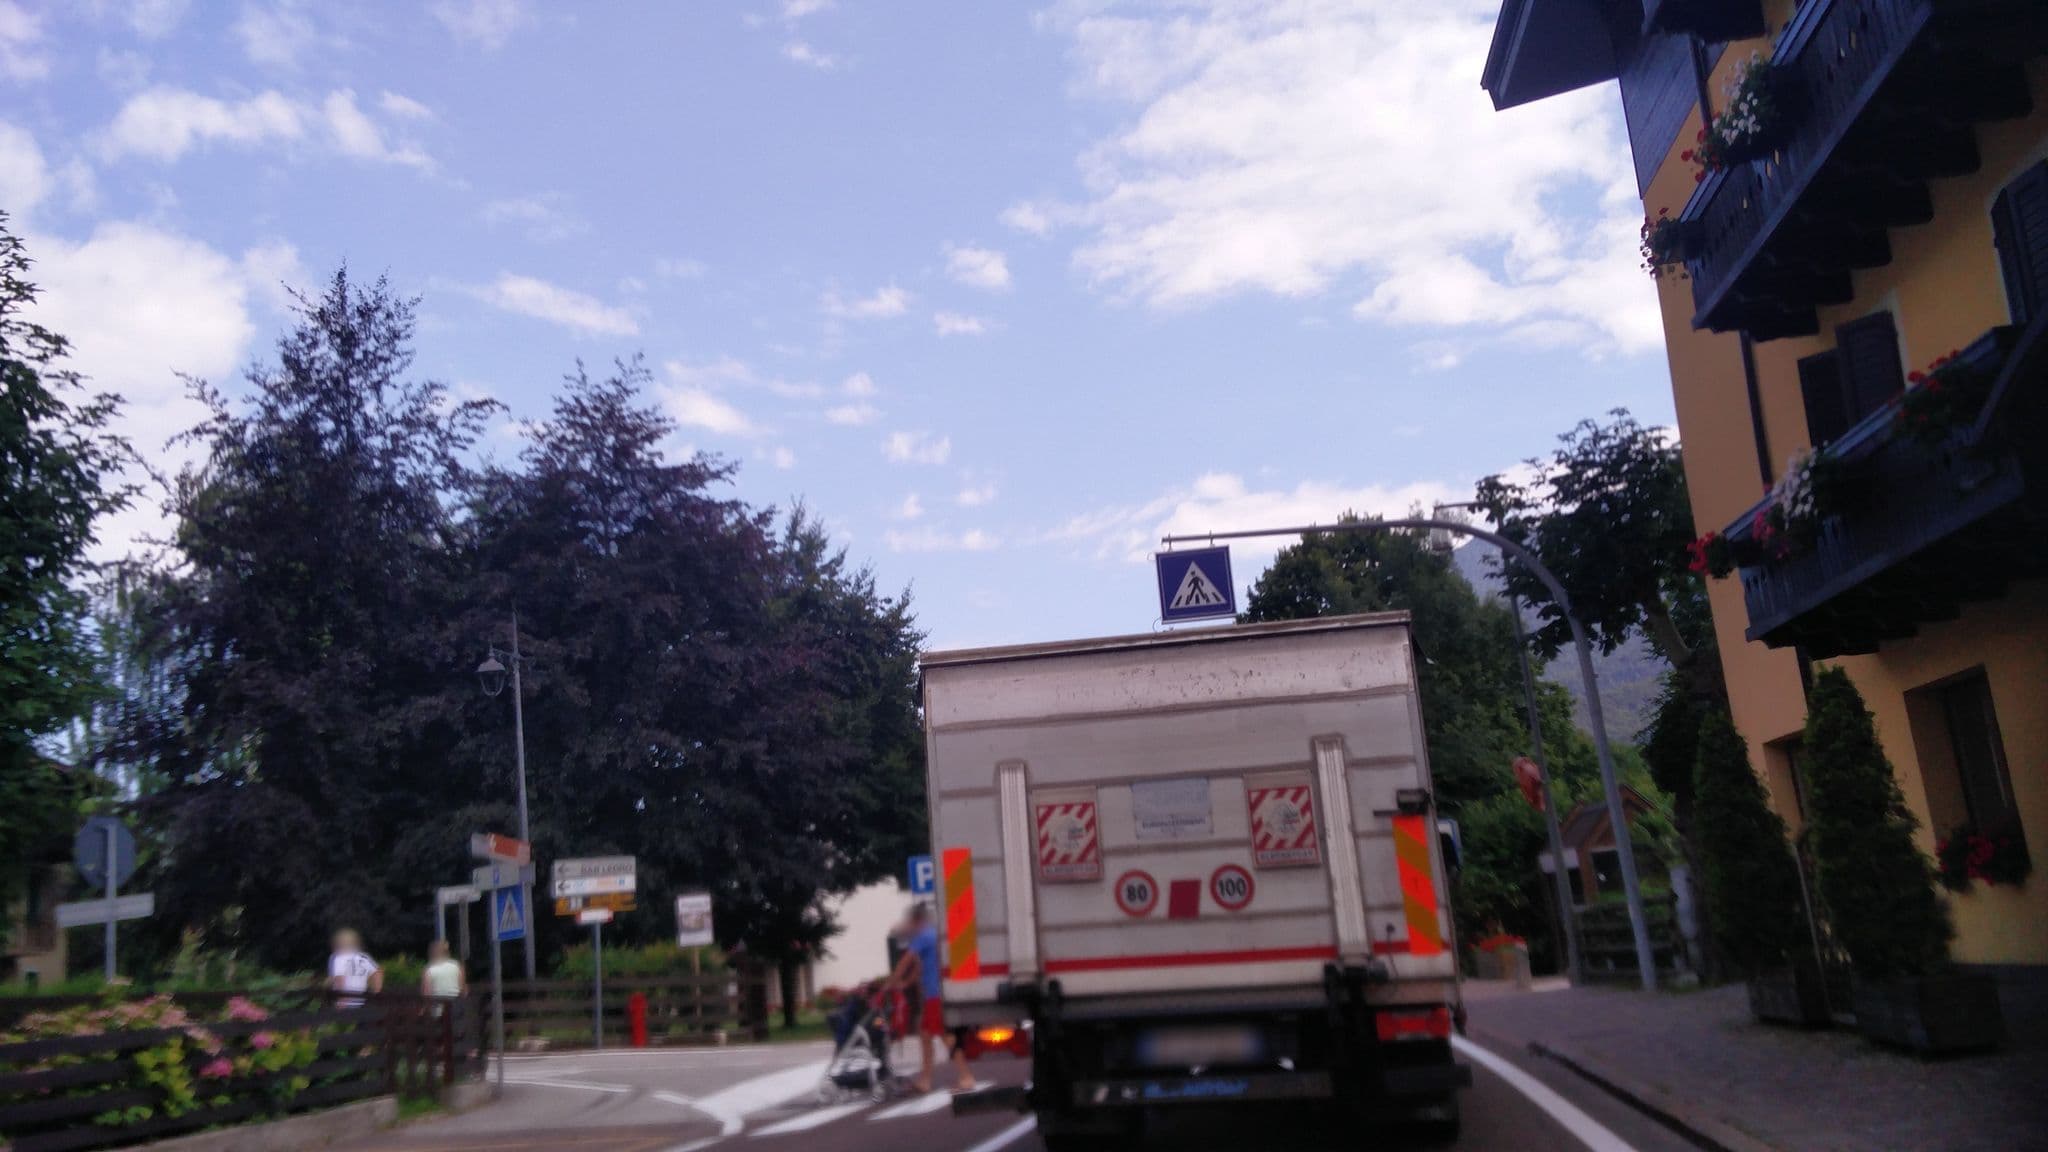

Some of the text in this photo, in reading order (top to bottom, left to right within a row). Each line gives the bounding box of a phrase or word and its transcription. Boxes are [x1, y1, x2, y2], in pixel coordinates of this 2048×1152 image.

[915, 861, 934, 889] P
[1126, 884, 1148, 902] 80
[1218, 877, 1247, 897] 100
